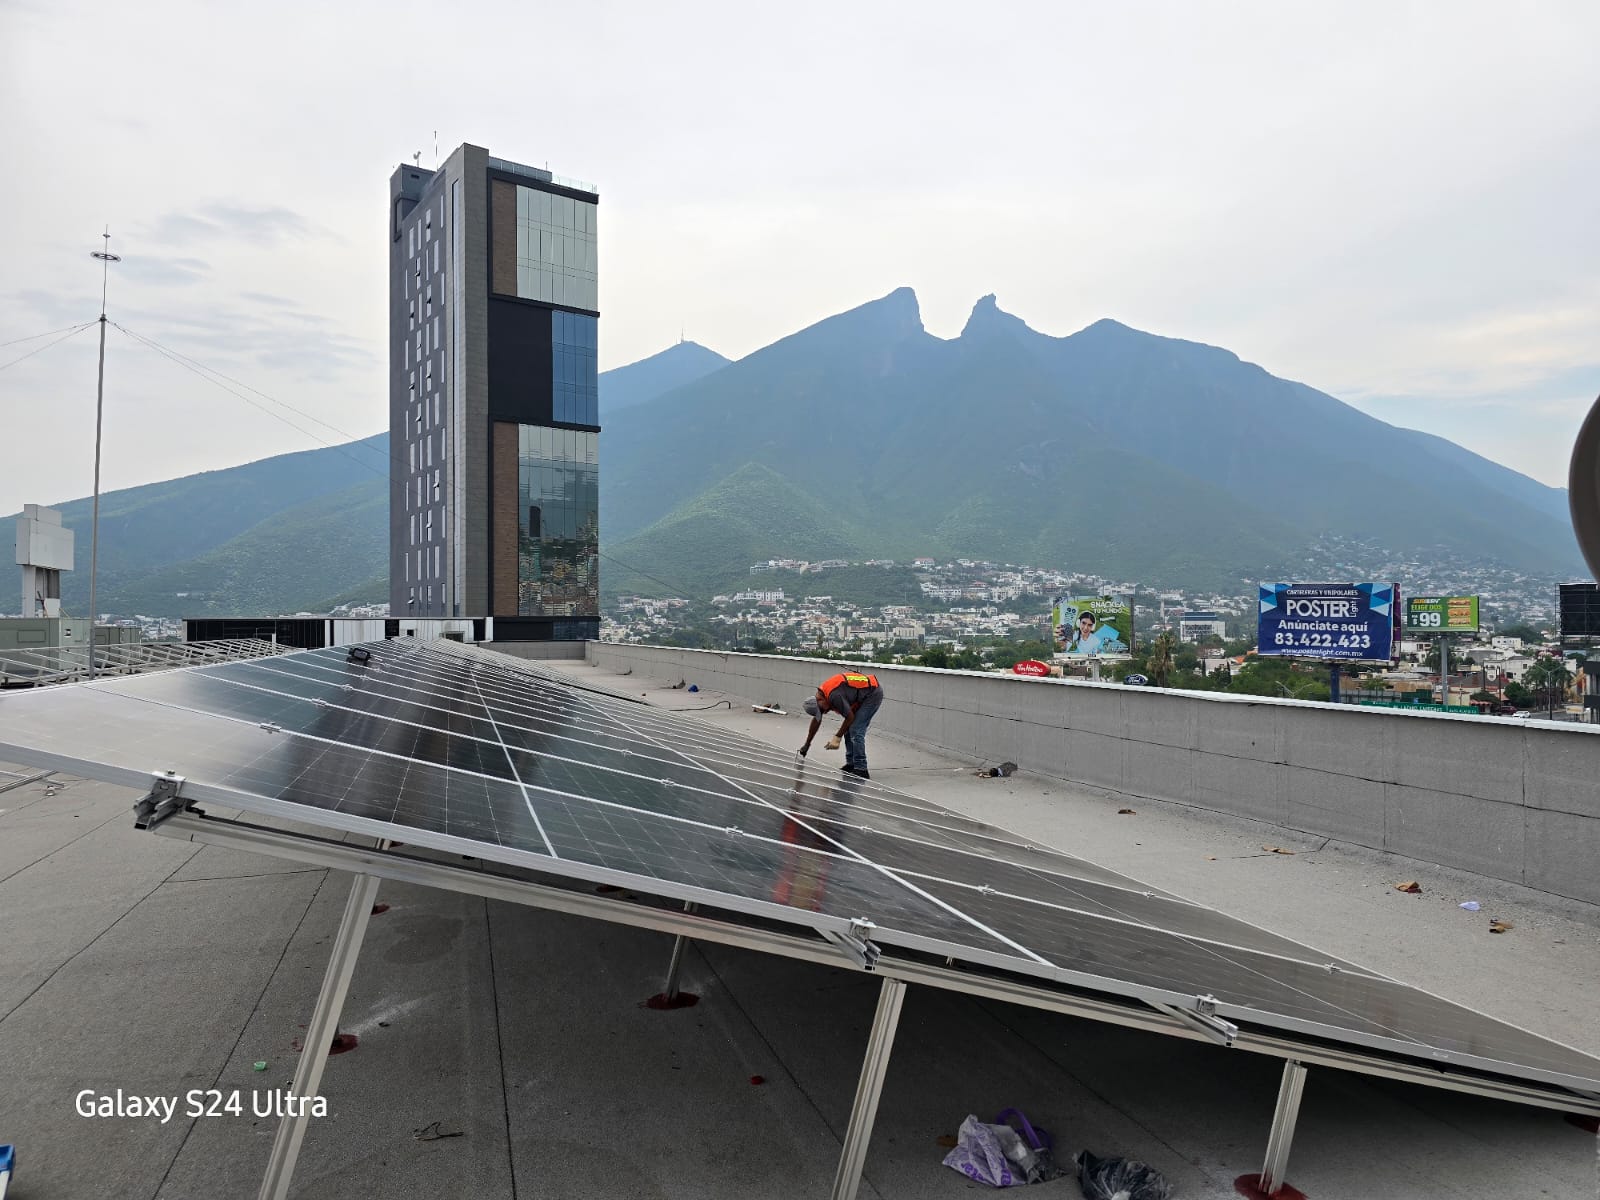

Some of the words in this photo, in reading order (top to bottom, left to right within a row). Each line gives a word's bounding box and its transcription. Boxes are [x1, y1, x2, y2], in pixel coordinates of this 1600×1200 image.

[1286, 599, 1350, 618] POSTER
[1278, 619, 1339, 632] Anúnciate
[1340, 621, 1368, 634] aquí
[1274, 632, 1371, 649] 83.422.423
